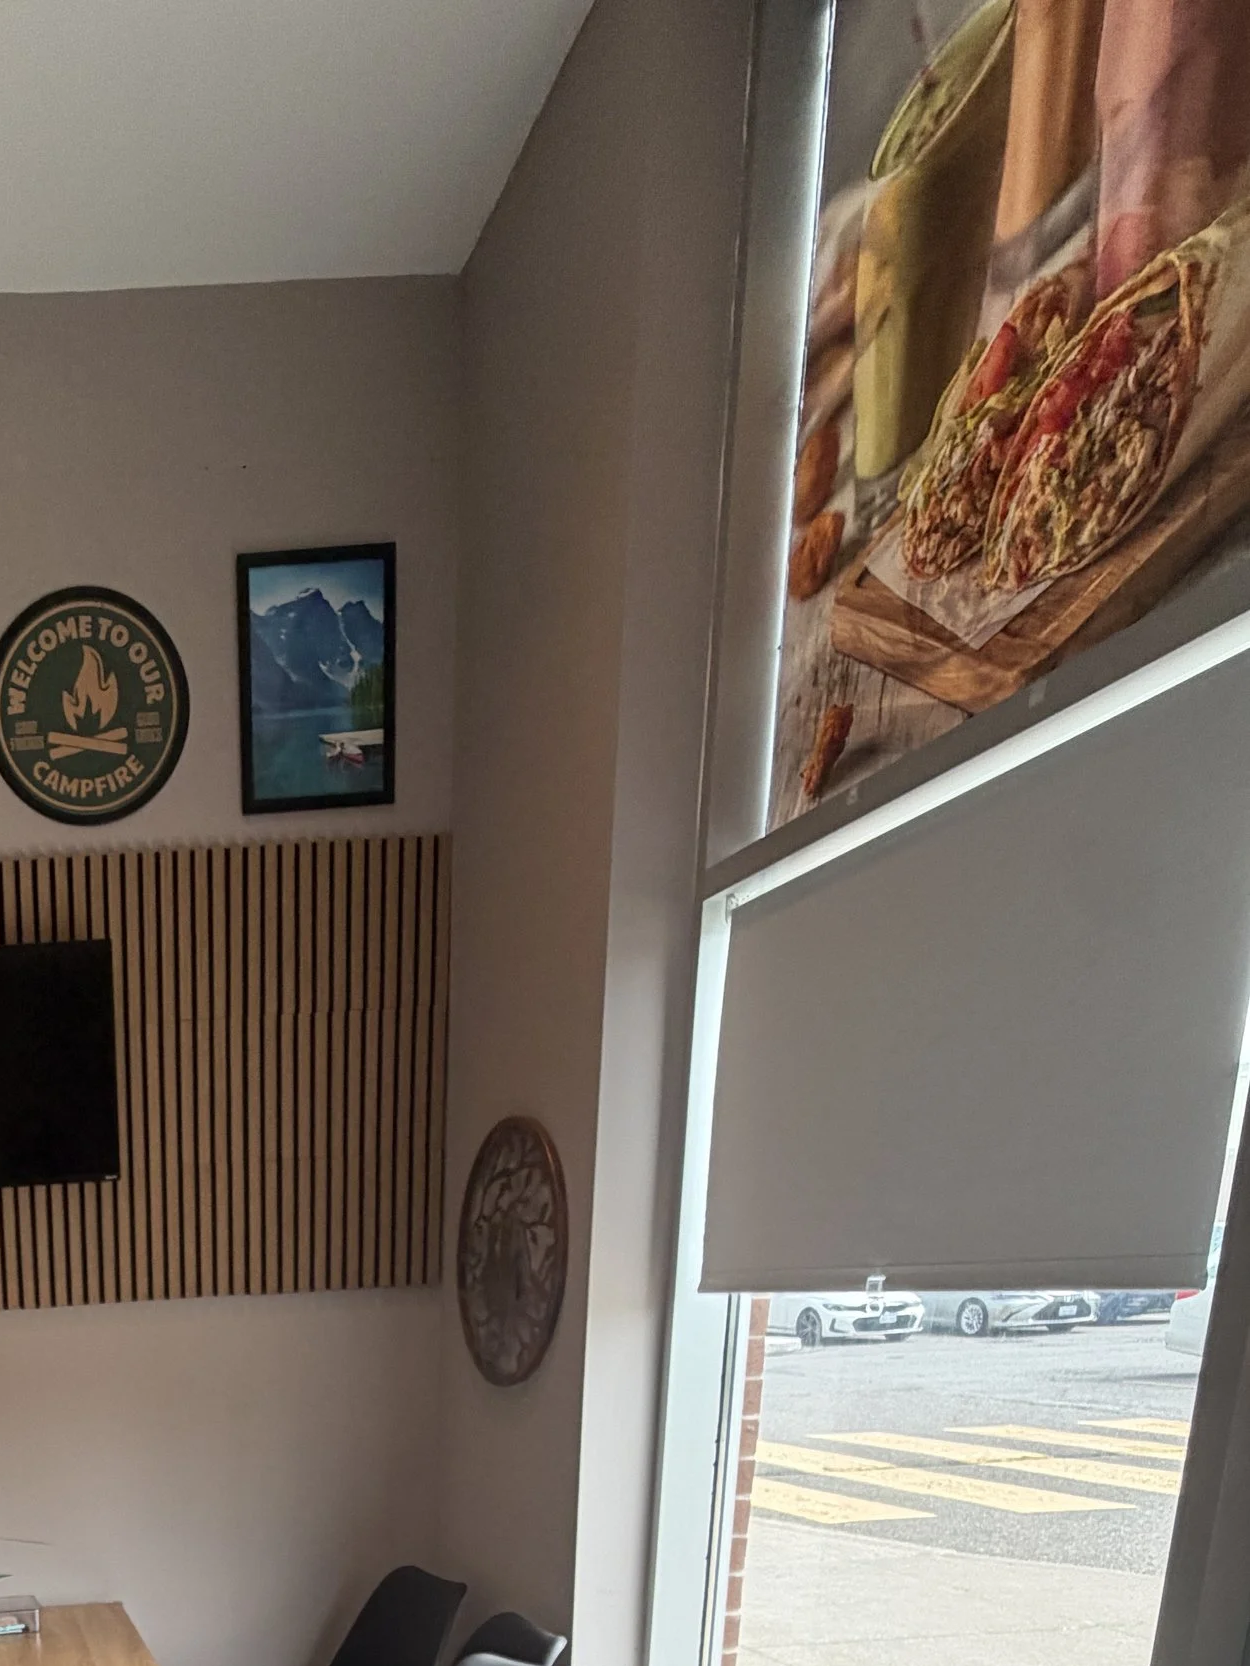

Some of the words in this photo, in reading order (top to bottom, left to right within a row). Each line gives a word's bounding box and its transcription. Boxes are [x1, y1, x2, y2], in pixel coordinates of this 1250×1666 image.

[7, 615, 92, 716] WELCOME
[98, 617, 129, 648] TO
[128, 641, 165, 705] OUR
[33, 754, 145, 799] CAMPFIRE
